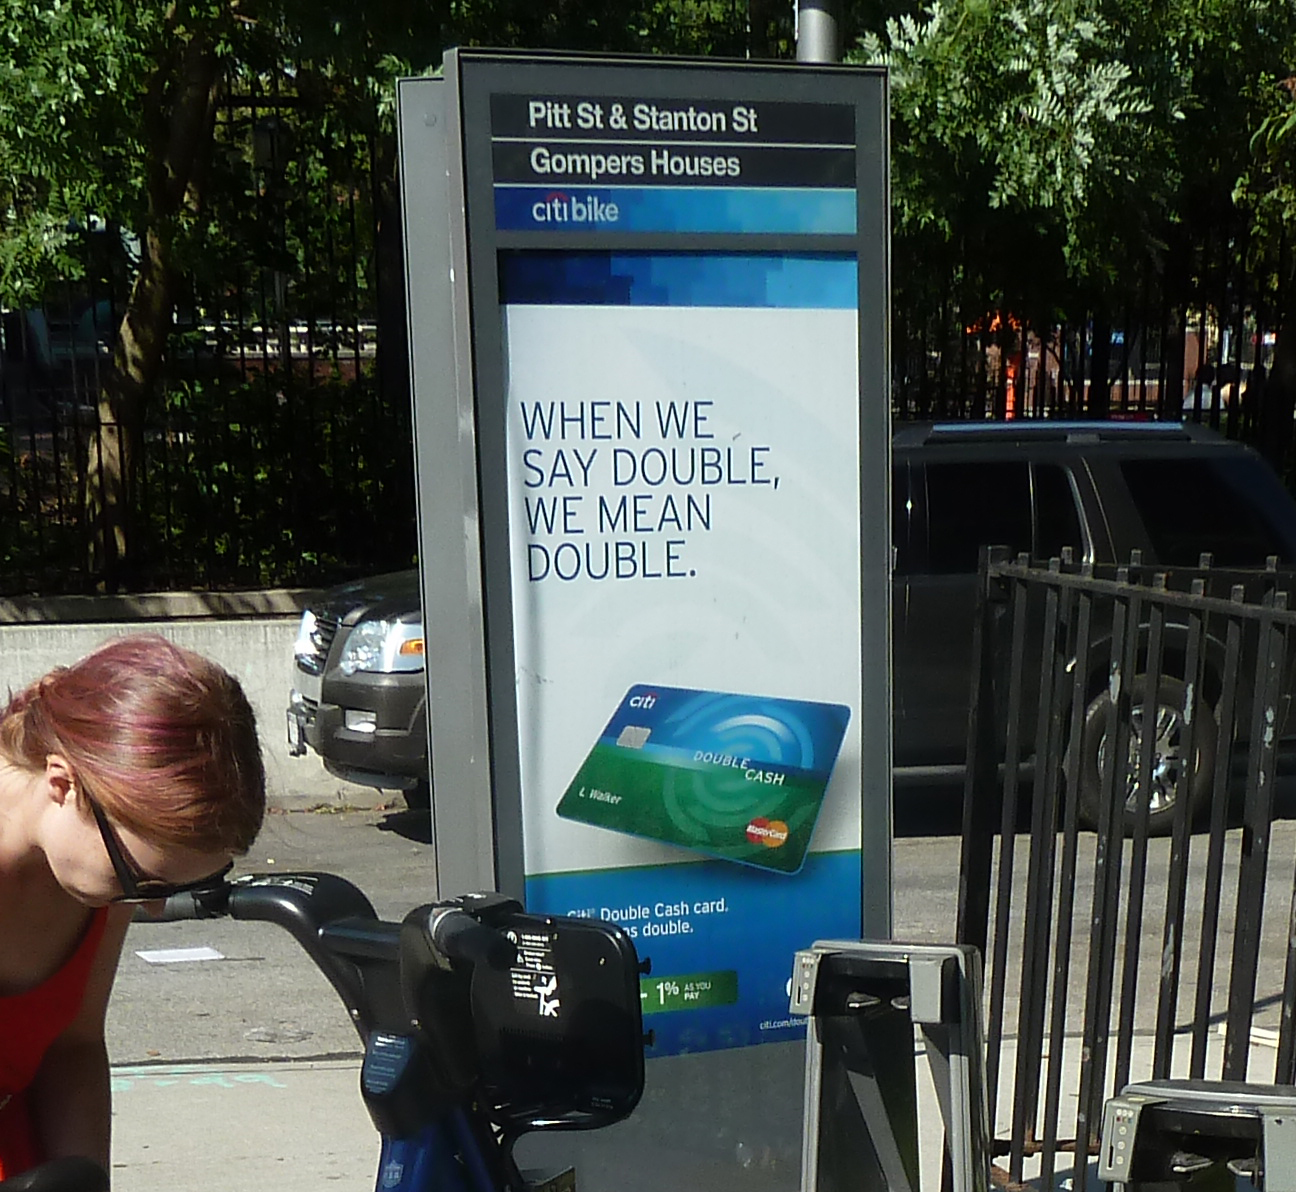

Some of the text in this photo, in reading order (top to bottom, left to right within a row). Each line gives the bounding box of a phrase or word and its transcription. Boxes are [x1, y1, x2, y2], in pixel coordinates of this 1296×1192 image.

[528, 101, 758, 133] Pitt St & Stanton St
[530, 147, 741, 179] Gompers Houses
[520, 401, 714, 440] WHEN WE
[523, 447, 780, 490] SAY DOUBLE,
[524, 494, 712, 535] WE MEAN
[528, 541, 697, 582] DOUBLE.
[629, 695, 656, 709] citi
[694, 750, 751, 770] DOUBLE
[745, 768, 785, 786] CASH
[600, 904, 650, 922] Double
[654, 901, 689, 918] Cash
[693, 897, 729, 914] card.
[643, 920, 694, 937] double.
[656, 981, 680, 1005] 1%
[684, 982, 711, 992] AS YOU
[684, 991, 700, 1001] PAY
